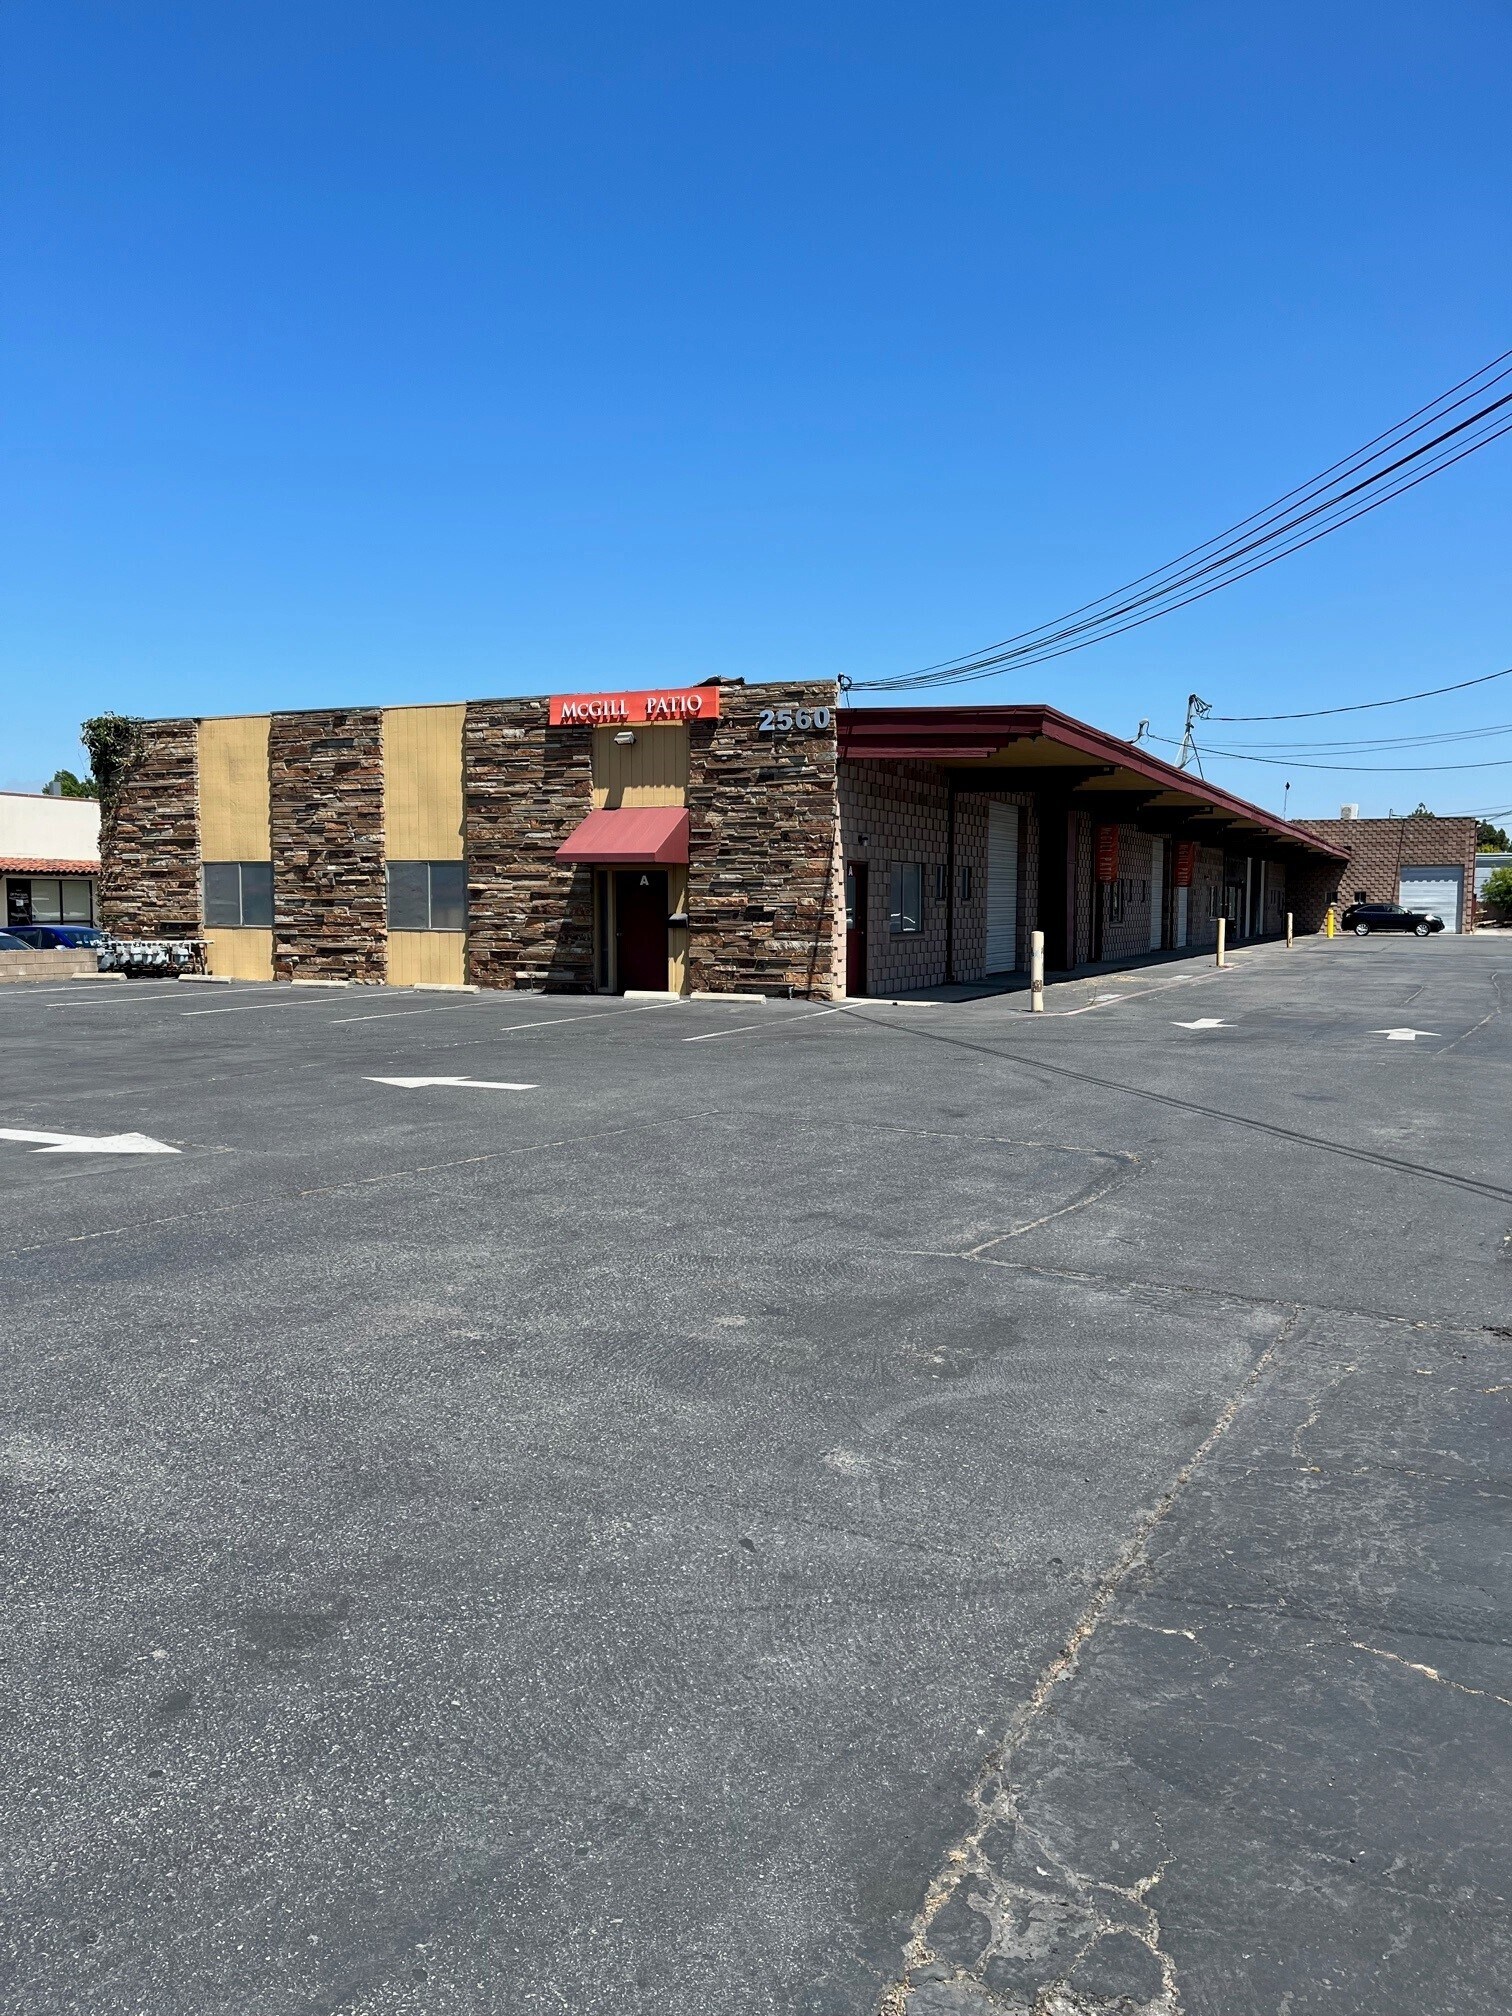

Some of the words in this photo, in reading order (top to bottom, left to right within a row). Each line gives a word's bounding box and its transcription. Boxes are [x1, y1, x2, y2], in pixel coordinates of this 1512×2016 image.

[646, 694, 702, 714] PATIO
[759, 706, 830, 731] 2560
[848, 865, 854, 876] A
[1100, 857, 1112, 880] PATIO
[640, 875, 649, 886] A
